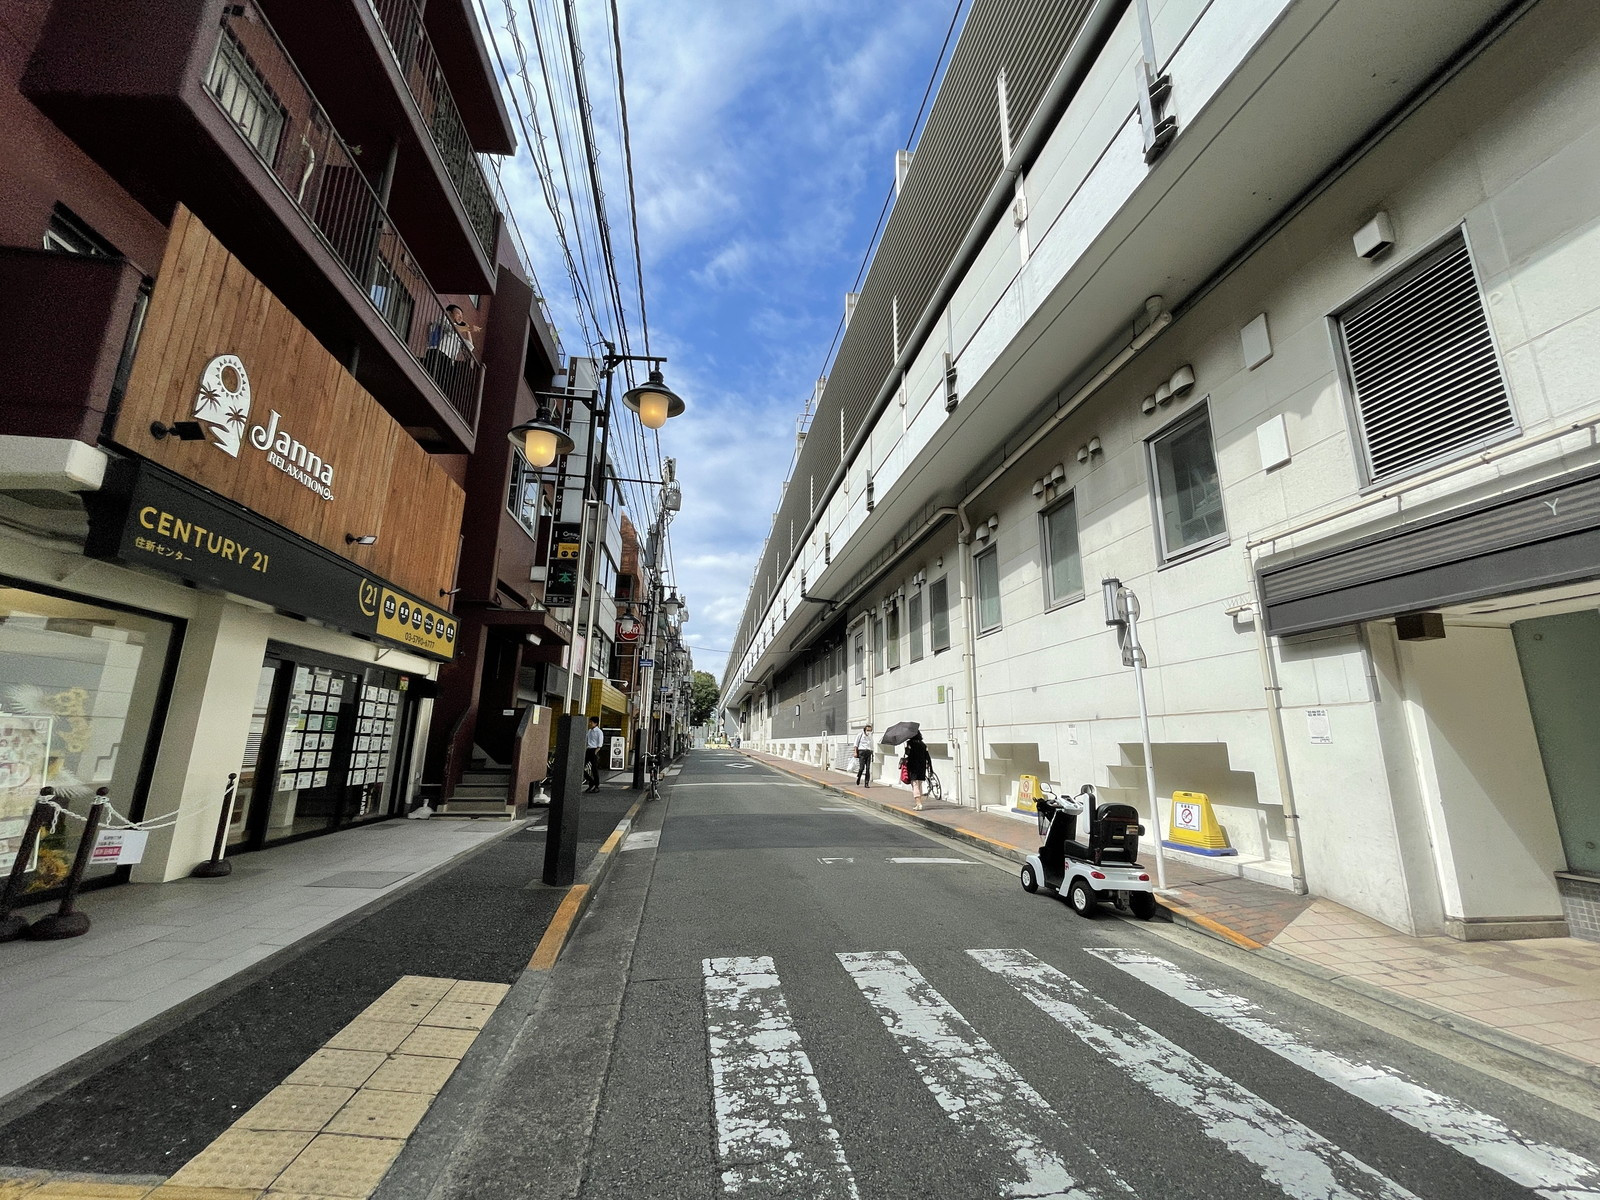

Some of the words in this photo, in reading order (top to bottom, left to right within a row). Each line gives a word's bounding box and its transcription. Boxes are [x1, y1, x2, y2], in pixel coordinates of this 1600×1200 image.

[251, 409, 334, 486] Janna
[267, 451, 334, 500] RELAXATION
[134, 536, 193, 561] 住新センター
[139, 506, 250, 565] CENTURY
[251, 551, 269, 573] 21
[364, 584, 378, 606] 21
